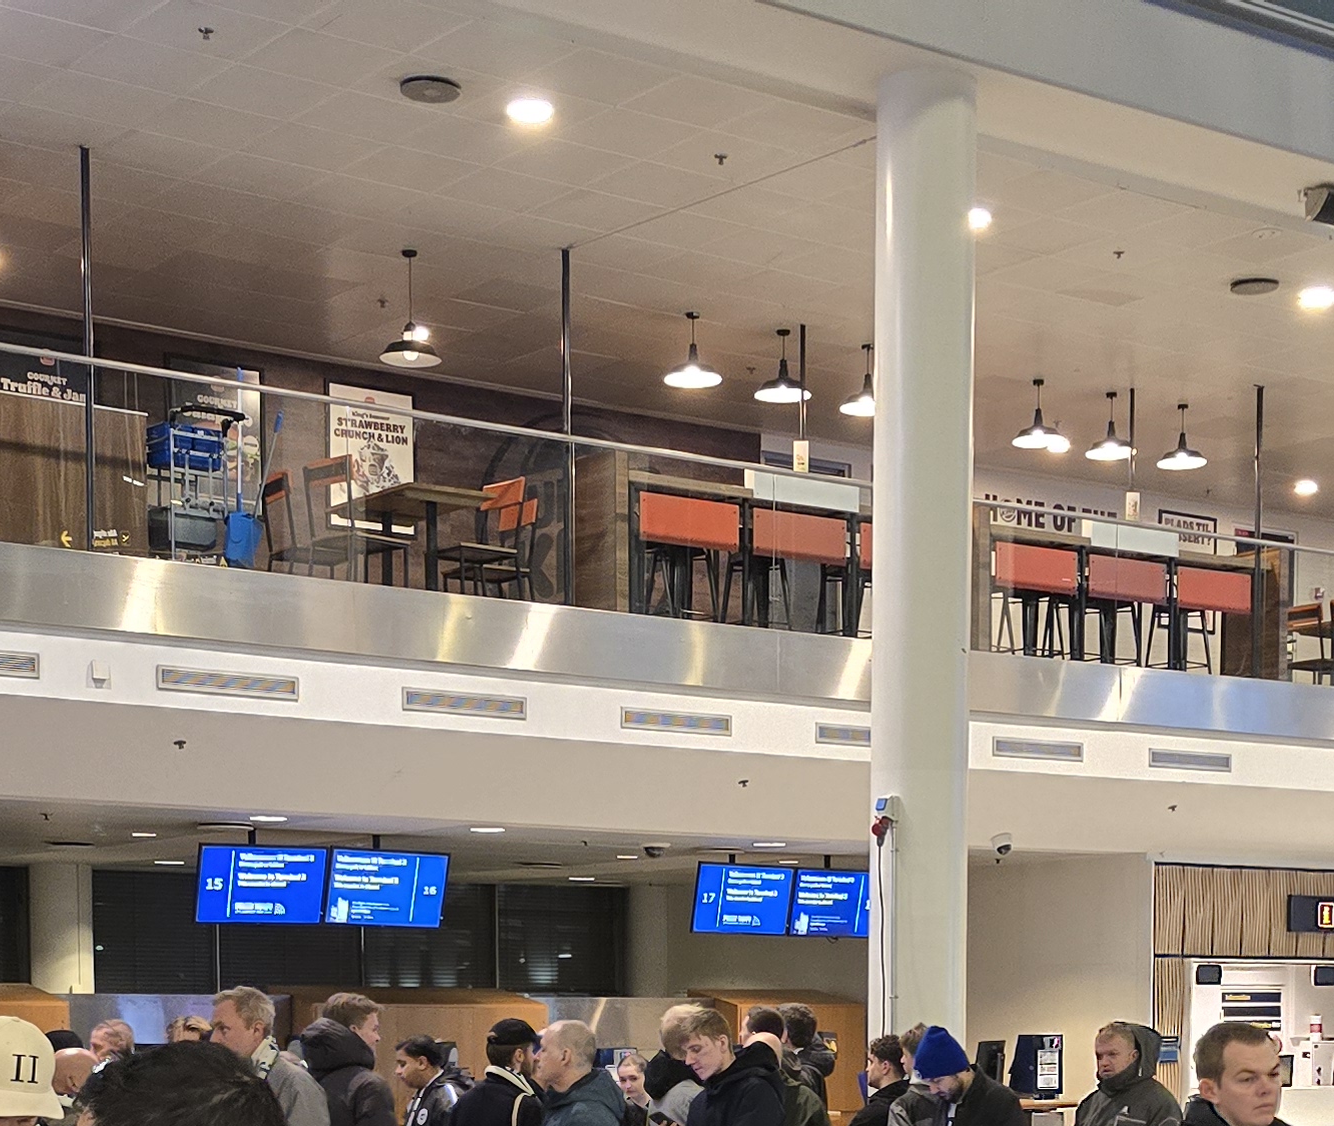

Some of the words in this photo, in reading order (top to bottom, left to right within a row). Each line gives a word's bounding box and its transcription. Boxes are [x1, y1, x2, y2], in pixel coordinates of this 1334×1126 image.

[1, 377, 48, 397] Truffle
[337, 417, 406, 434] STRAWBERRY
[334, 428, 375, 441] CRUNCH
[377, 434, 384, 443] &
[386, 435, 408, 445] LION
[205, 877, 224, 890] 15
[702, 892, 716, 903] 17
